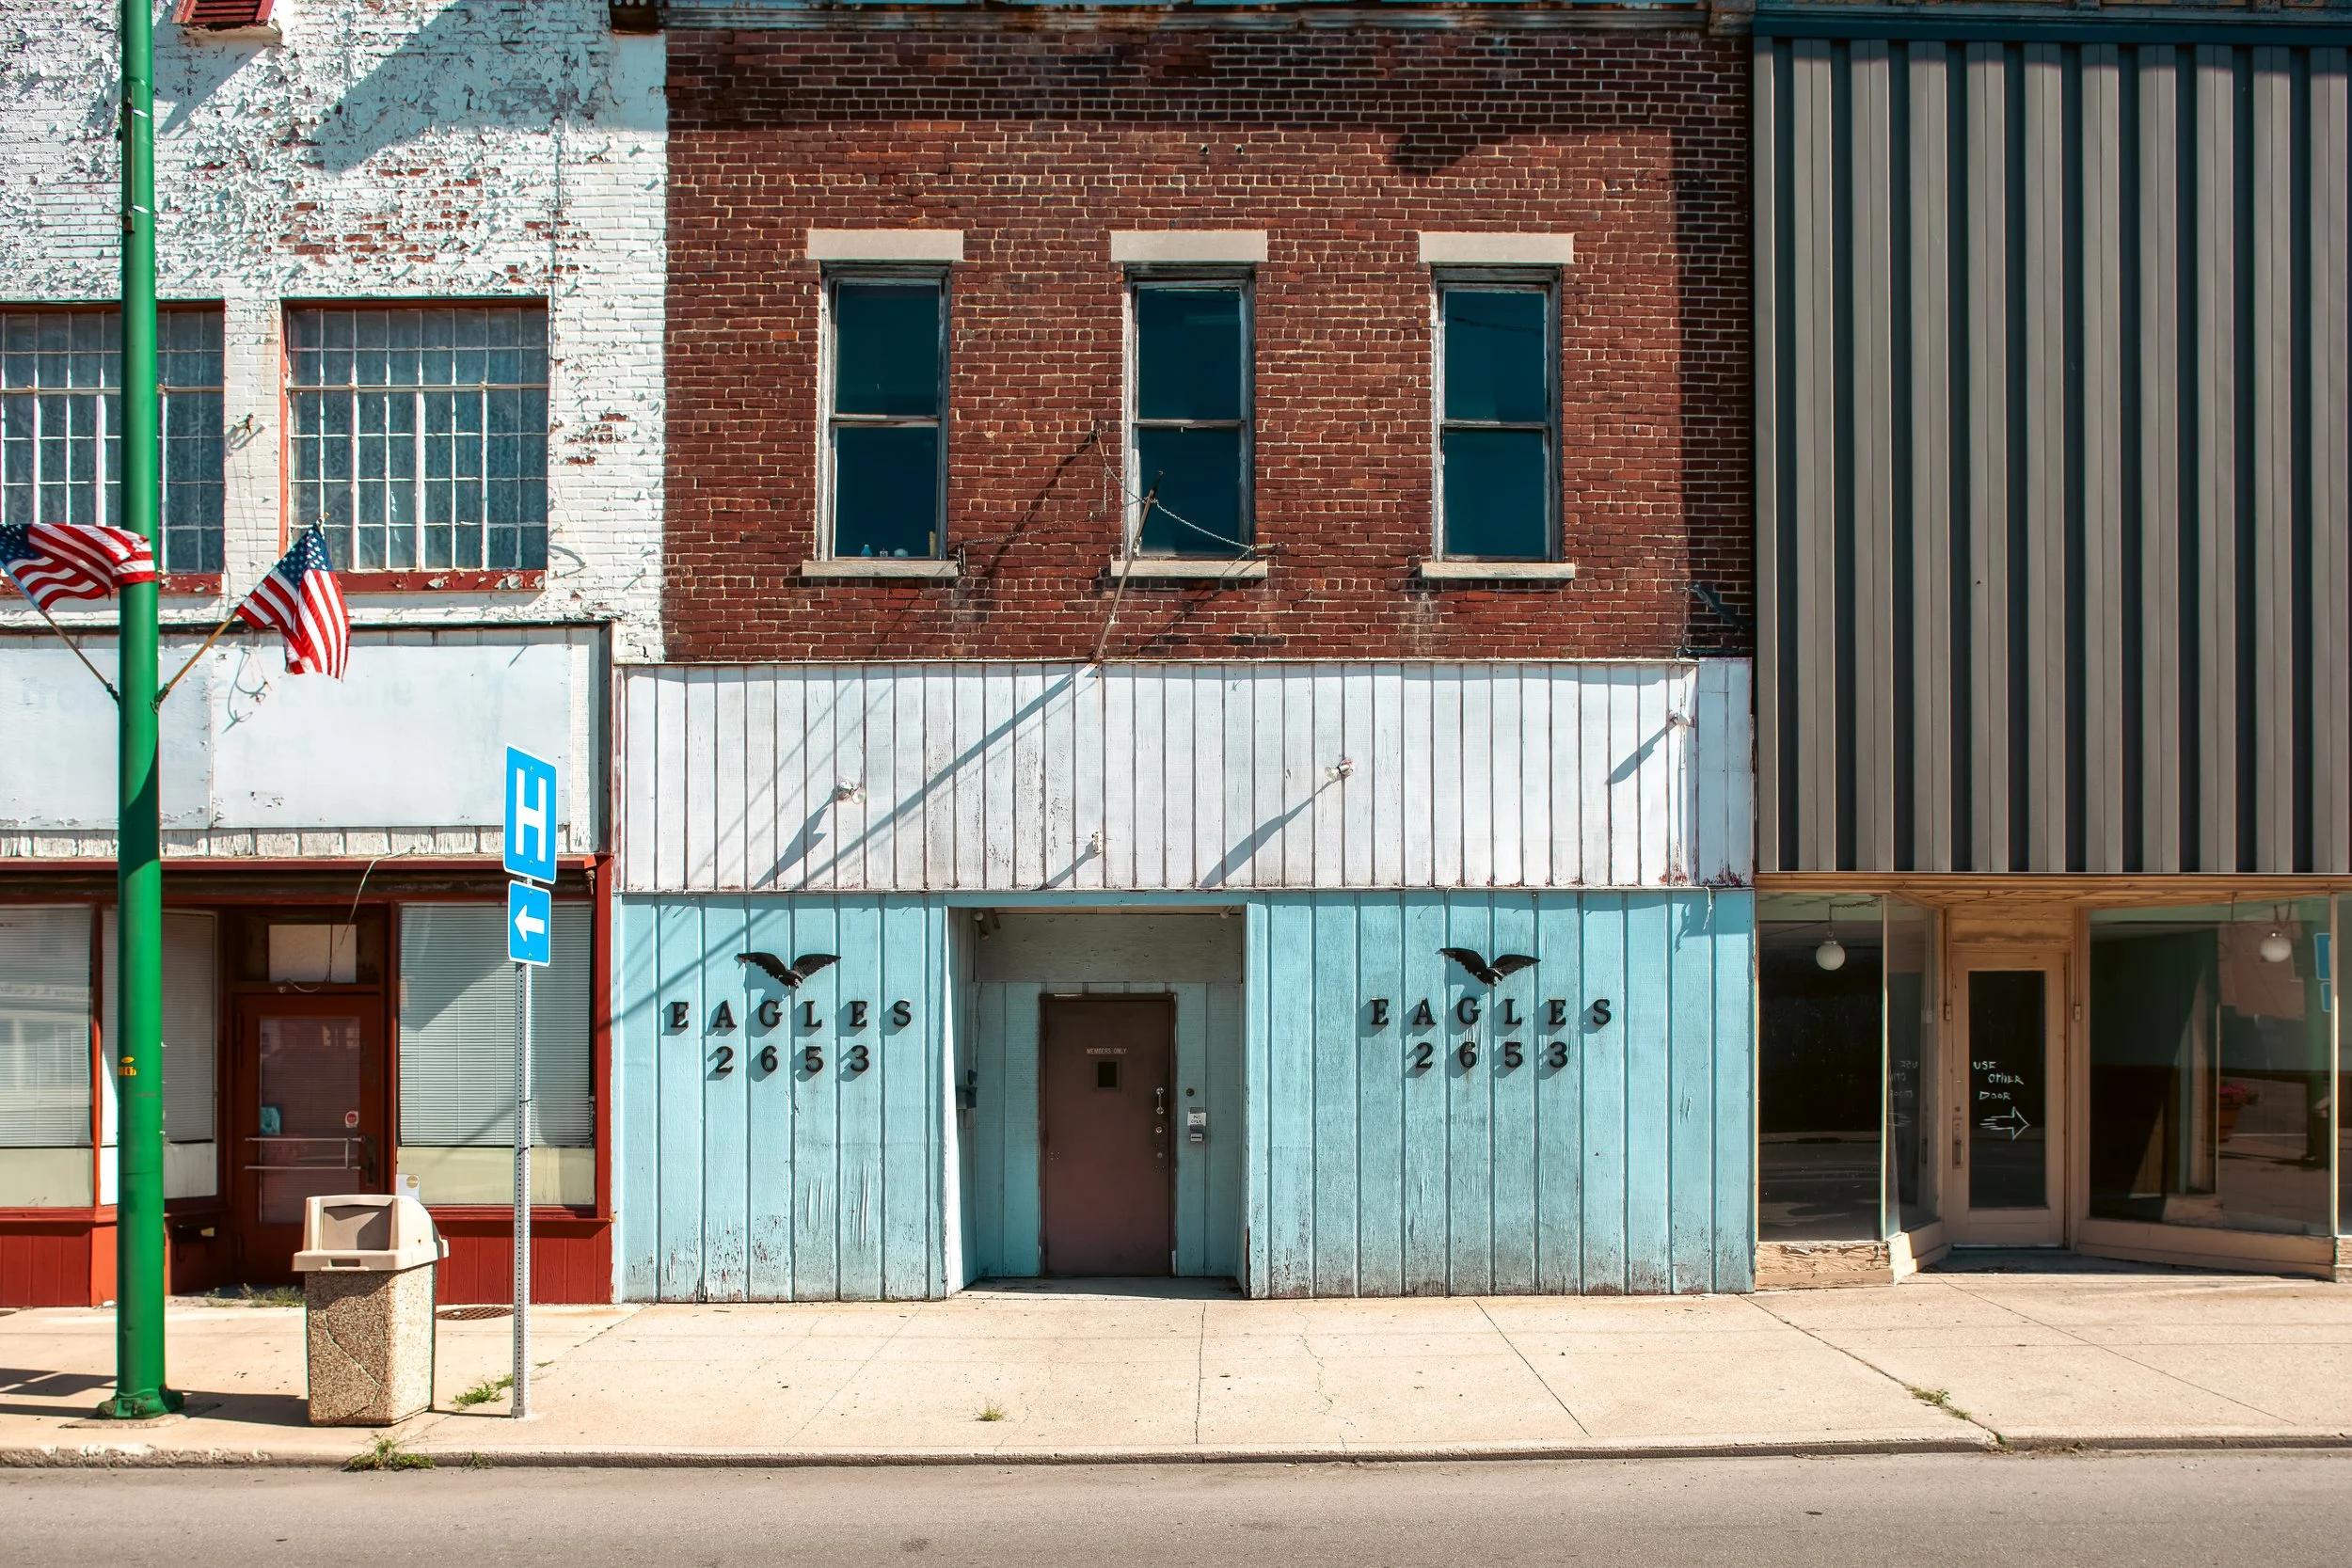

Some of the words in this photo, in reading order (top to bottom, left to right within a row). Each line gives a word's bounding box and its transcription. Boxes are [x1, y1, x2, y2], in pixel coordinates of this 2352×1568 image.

[515, 768, 547, 863] H
[671, 1000, 912, 1028] EAGLES
[1371, 997, 1612, 1025] EAGLES
[716, 1045, 869, 1072] 2653
[1416, 1041, 1568, 1069] 2653
[1973, 1060, 1996, 1070] USE
